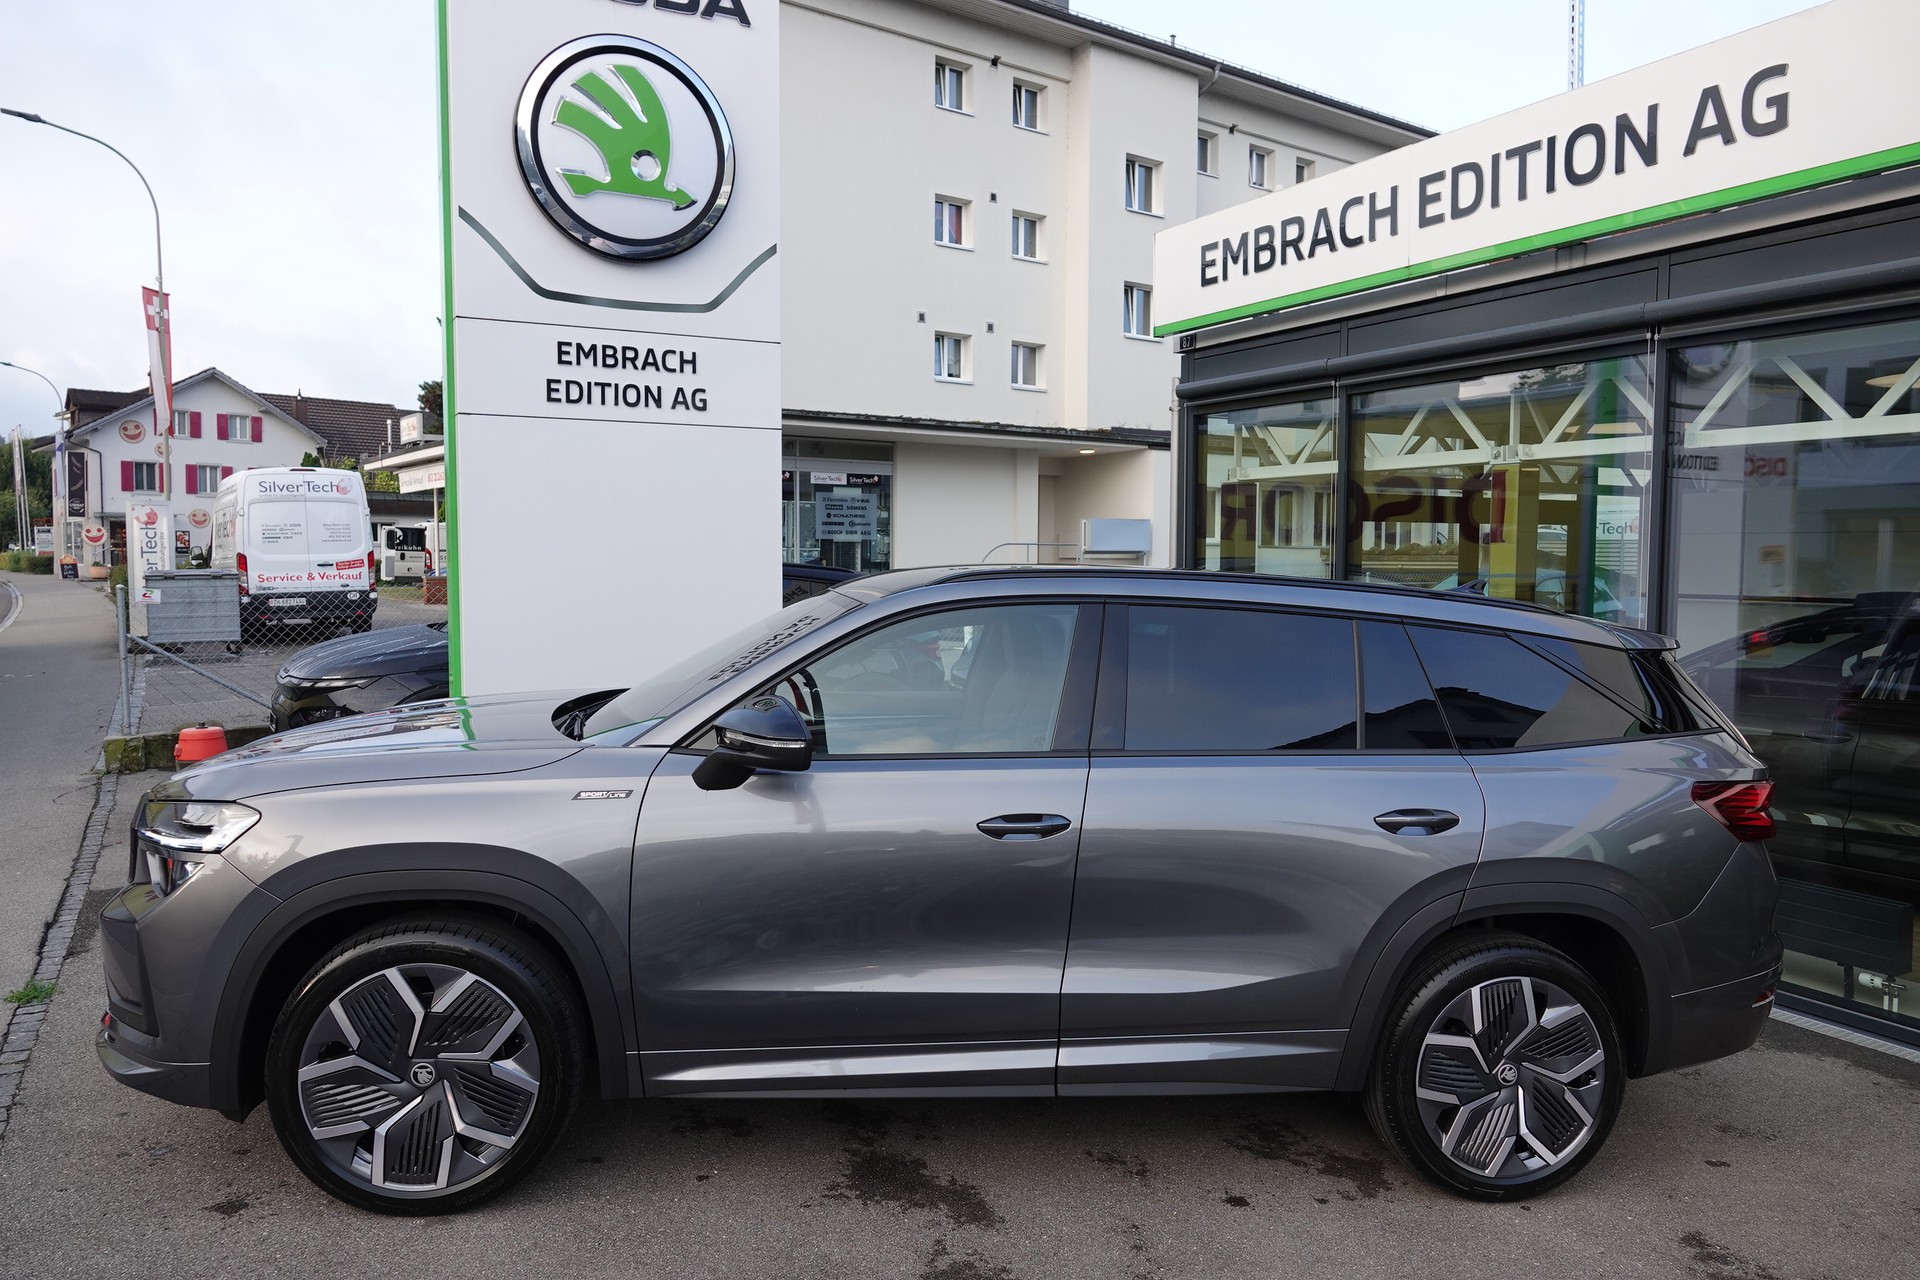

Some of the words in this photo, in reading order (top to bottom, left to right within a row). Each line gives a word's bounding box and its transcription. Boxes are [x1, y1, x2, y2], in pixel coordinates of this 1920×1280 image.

[1199, 183, 1401, 288] EMBRACH
[1417, 102, 1660, 230] EDITION
[1682, 61, 1791, 158] AG
[1182, 336, 1192, 348] 87
[556, 341, 698, 375] EMBRACH
[545, 379, 662, 410] EDITION
[670, 386, 708, 412] AG
[258, 481, 340, 493] SilverTech
[257, 573, 303, 583] Service
[306, 572, 316, 581] &
[317, 571, 363, 581] Verkauf
